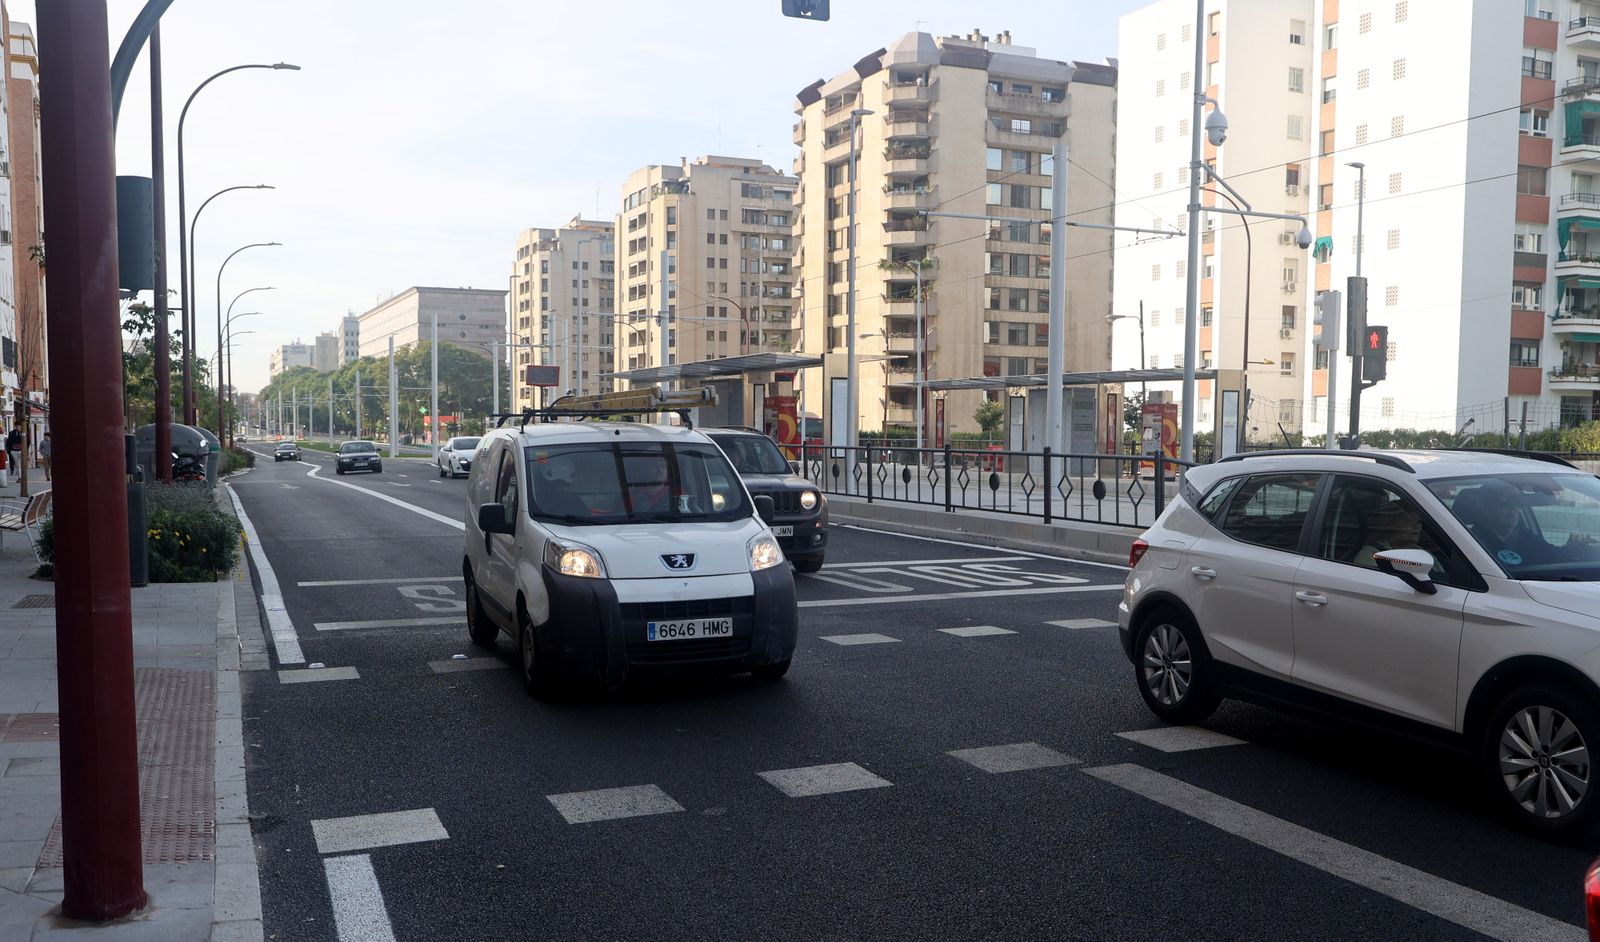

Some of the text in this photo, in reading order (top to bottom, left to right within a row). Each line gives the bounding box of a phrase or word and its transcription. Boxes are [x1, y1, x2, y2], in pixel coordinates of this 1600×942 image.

[777, 527, 792, 535] JMN
[659, 620, 730, 638] 6646 HMG
